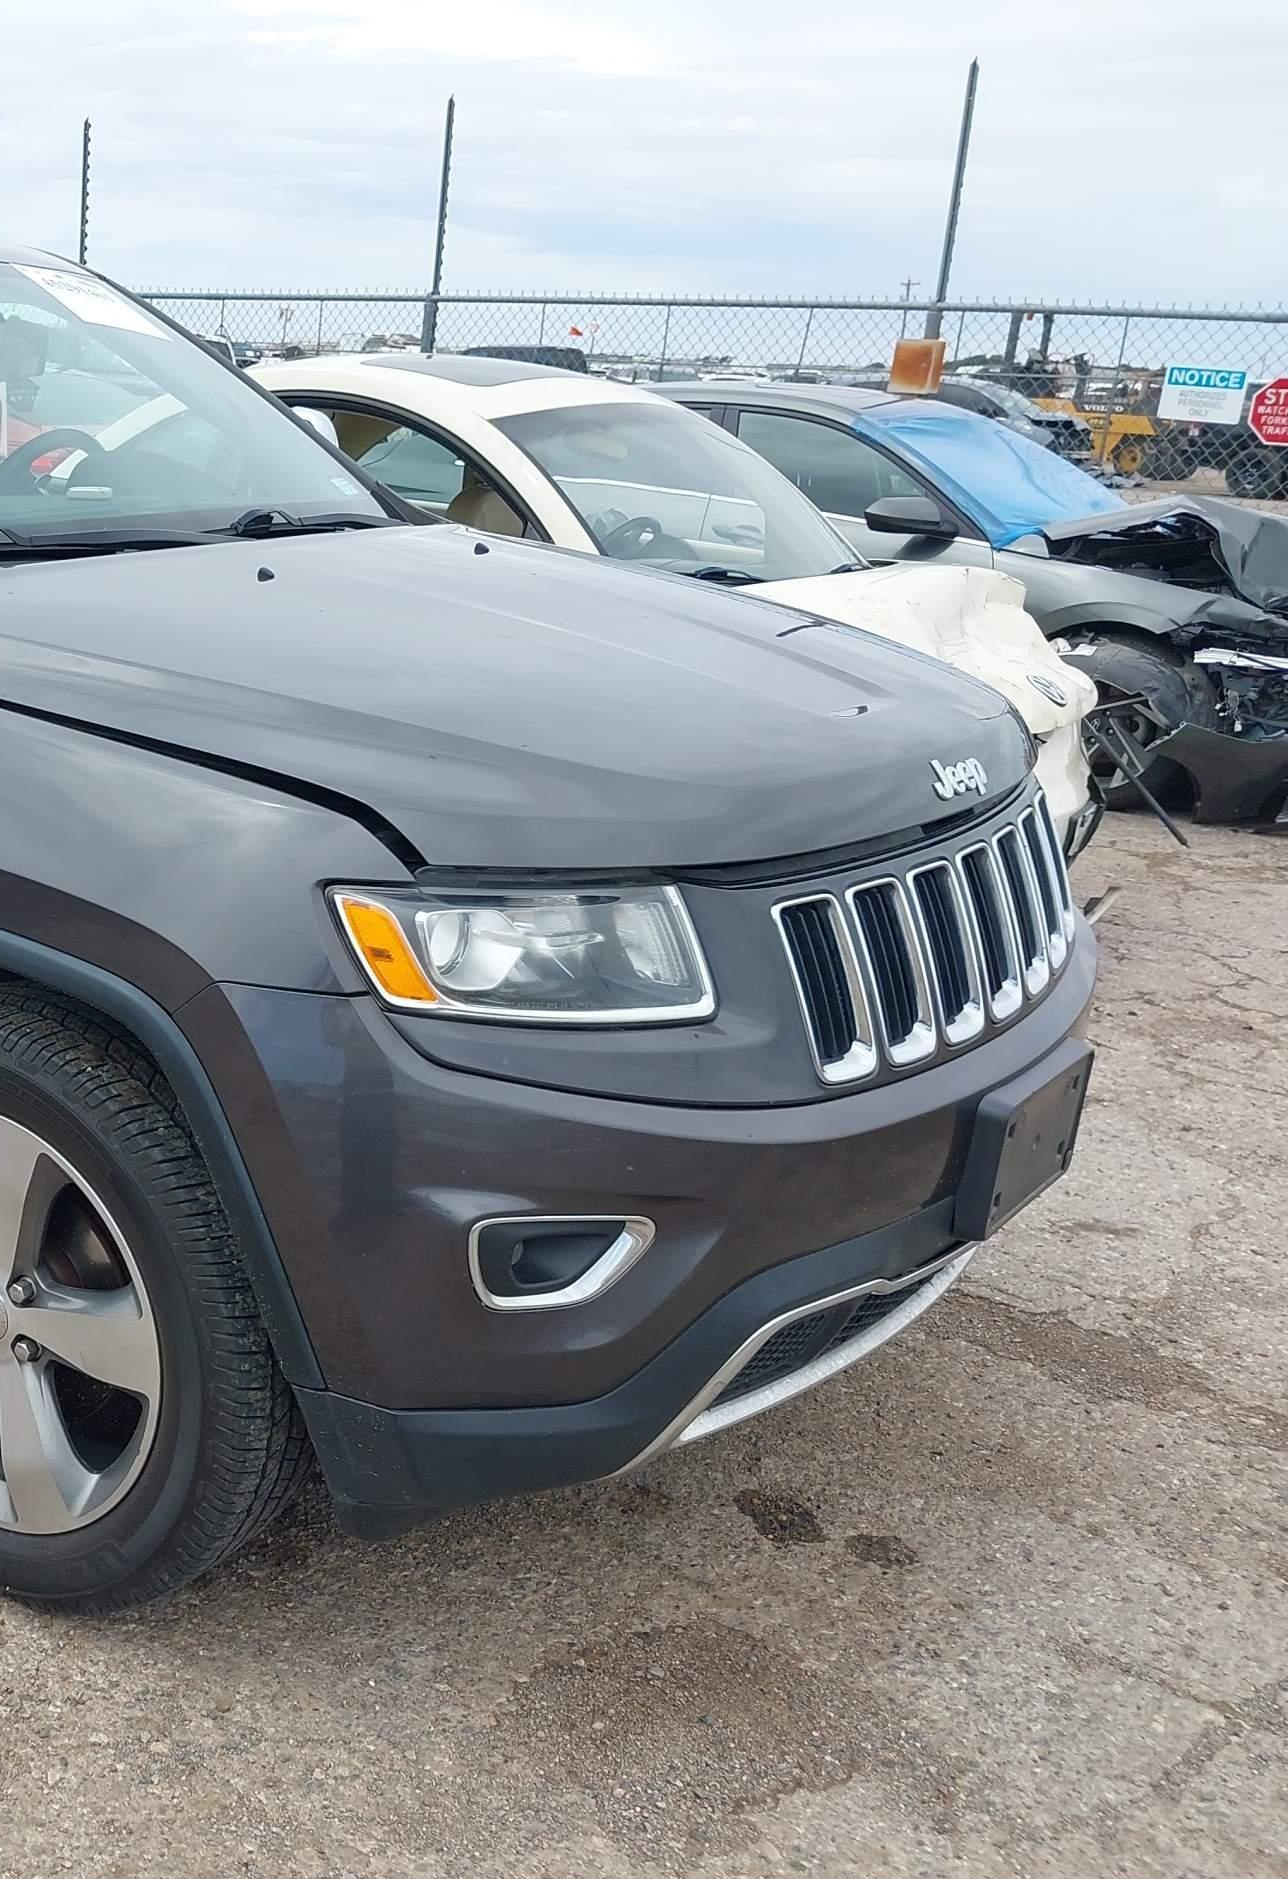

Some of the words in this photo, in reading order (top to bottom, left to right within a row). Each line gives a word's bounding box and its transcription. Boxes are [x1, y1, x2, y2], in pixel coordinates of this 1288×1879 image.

[1171, 368, 1243, 389] NOTICE
[1082, 403, 1125, 413] VOLO
[1188, 408, 1210, 418] ONLY
[929, 757, 988, 800] Jeep
